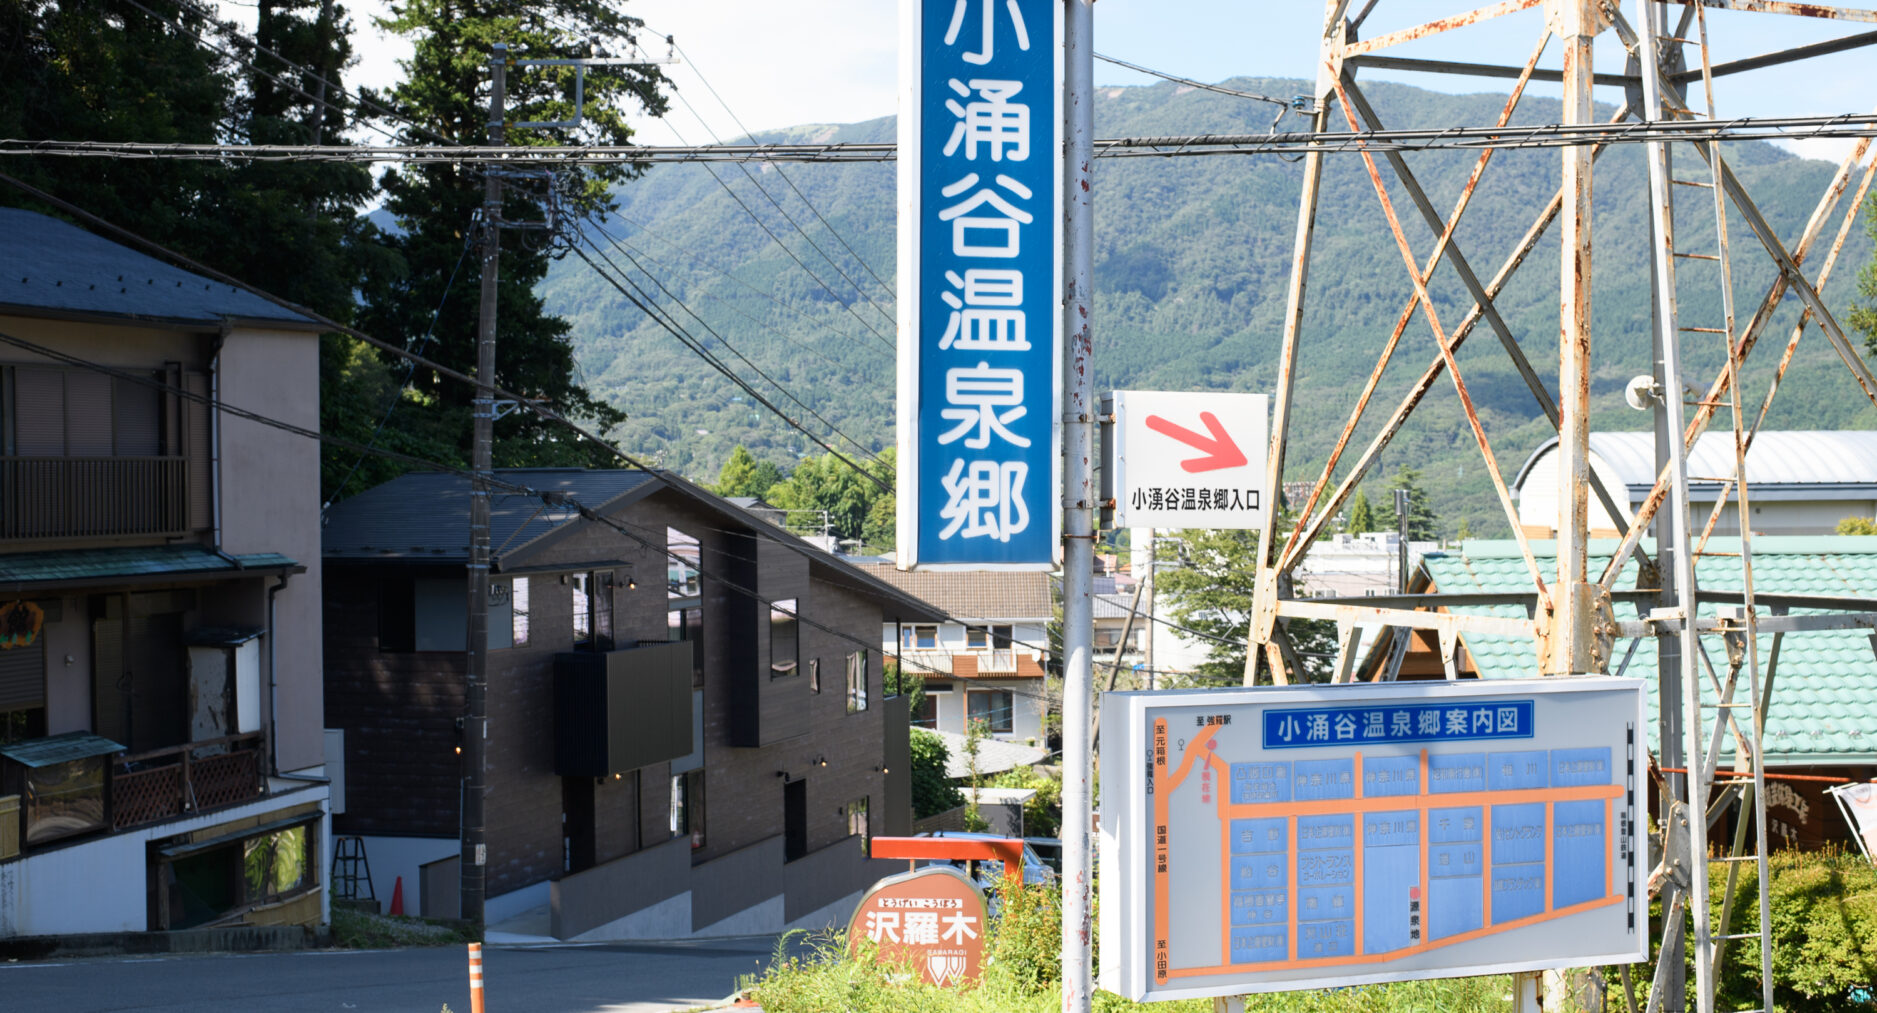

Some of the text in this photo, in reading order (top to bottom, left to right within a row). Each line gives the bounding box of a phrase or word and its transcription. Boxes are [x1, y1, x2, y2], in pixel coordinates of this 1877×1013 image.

[937, 0, 1034, 543] 小涌谷温泉郷
[1131, 487, 1260, 511] 小湧谷温泉郷入口
[1278, 706, 1519, 742] 小涌谷温泉郷案内図
[1156, 825, 1167, 873] 国道一号線
[882, 898, 918, 908] とうげい
[1409, 900, 1421, 940] 源泉地
[865, 910, 978, 945] 沢羅木
